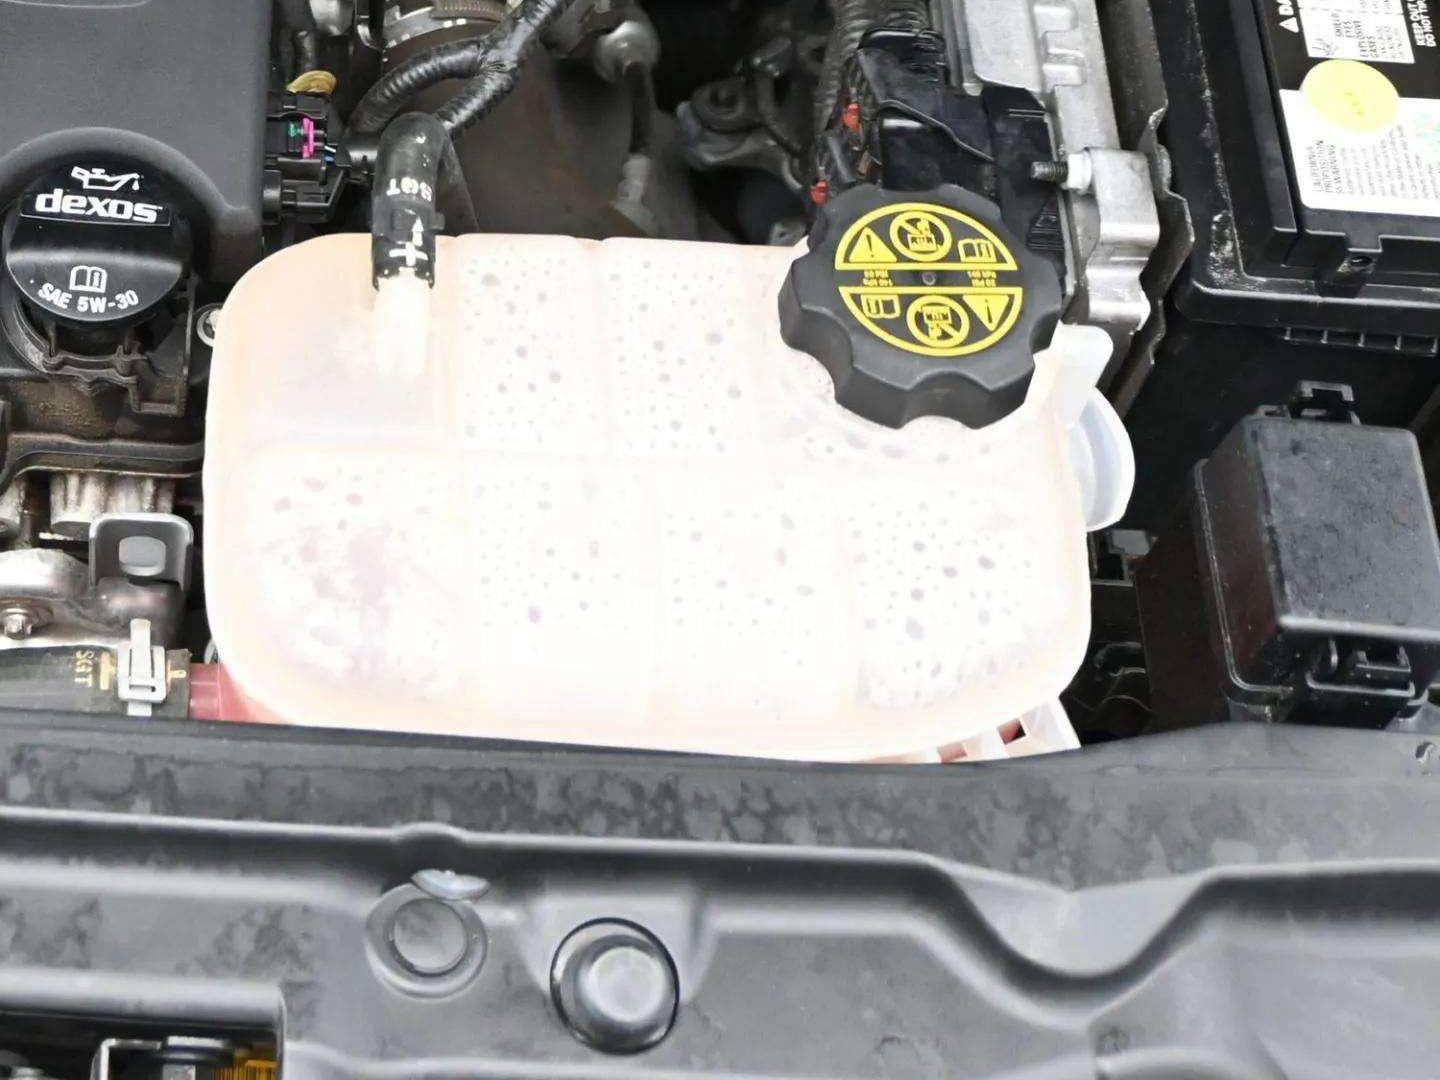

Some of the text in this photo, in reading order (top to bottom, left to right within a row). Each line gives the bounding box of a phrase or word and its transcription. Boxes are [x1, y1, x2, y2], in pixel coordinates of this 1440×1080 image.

[1407, 3, 1419, 21] OUT
[1412, 22, 1426, 46] KEEP
[37, 281, 139, 313] SAE 5W-30
[74, 649, 96, 688] SGT
